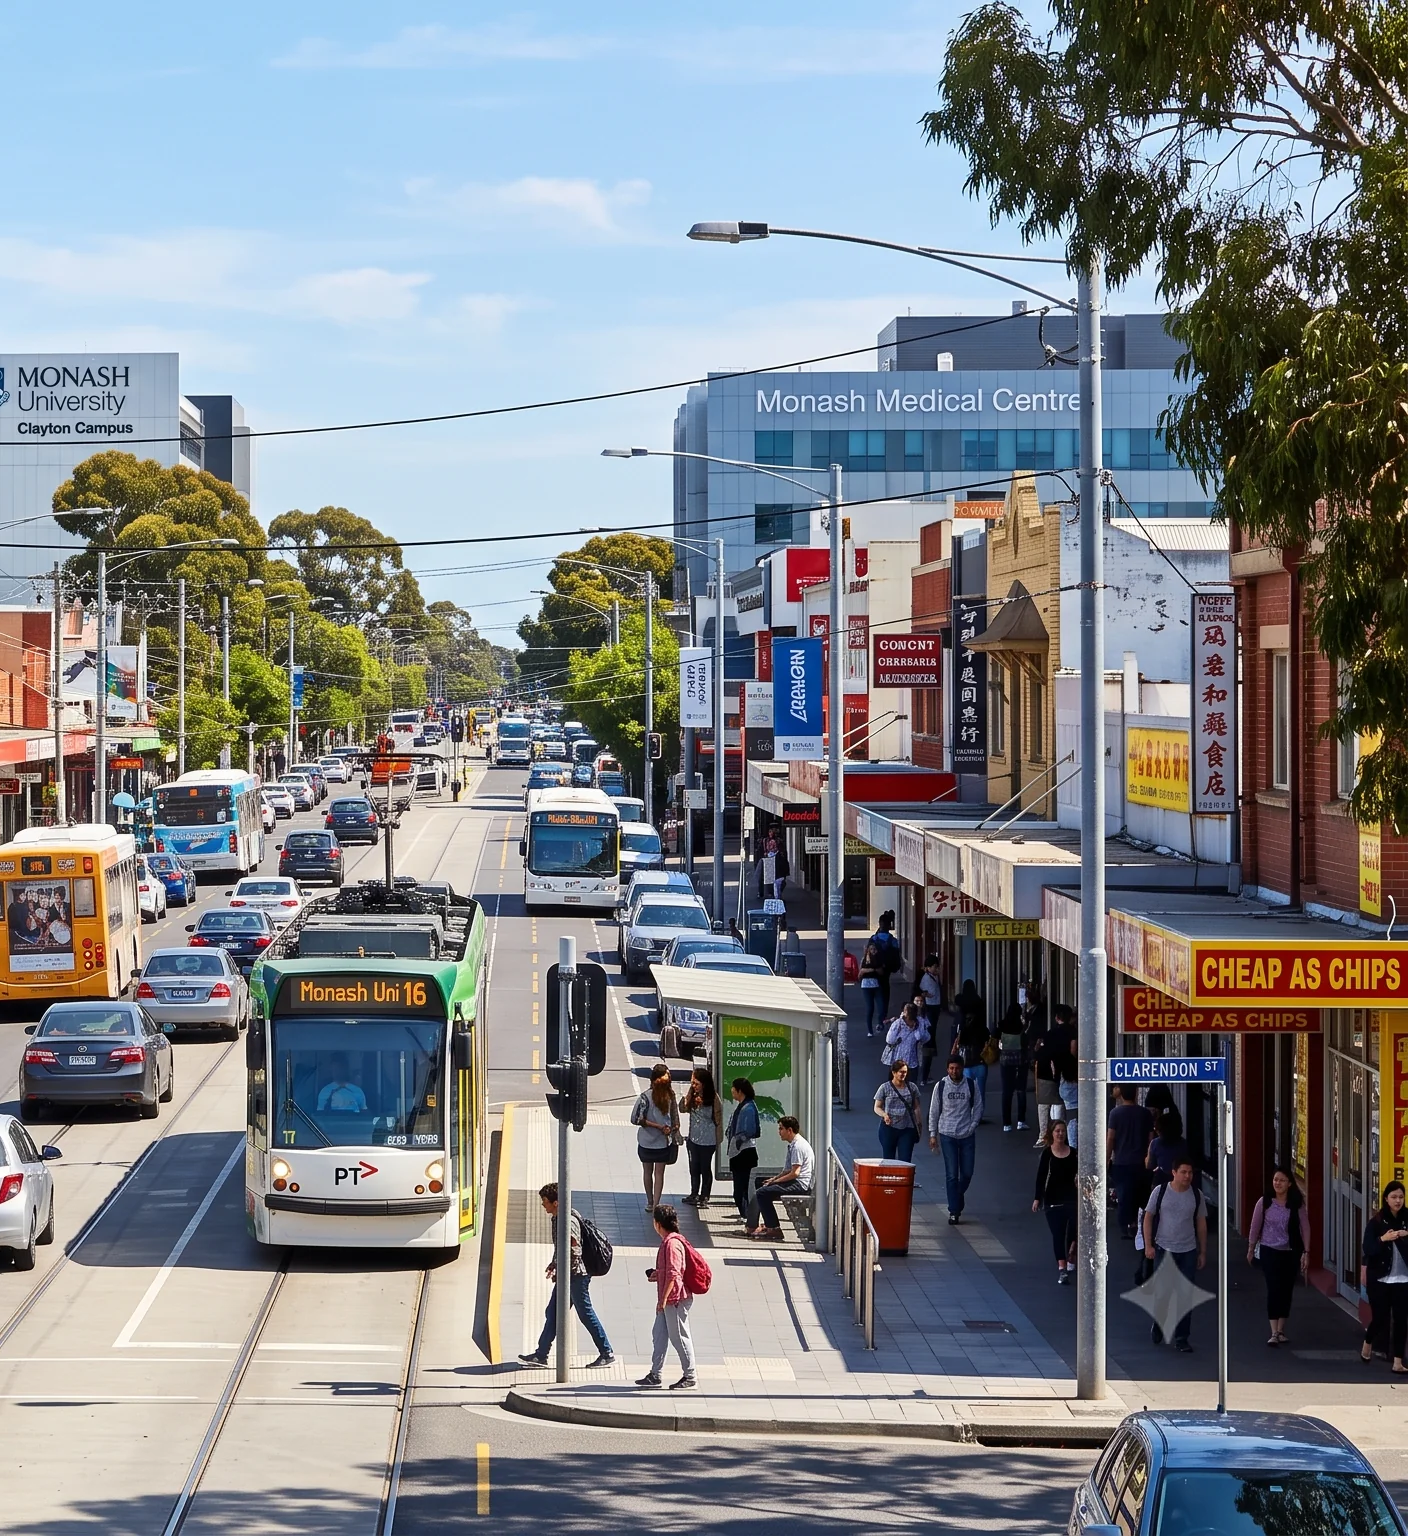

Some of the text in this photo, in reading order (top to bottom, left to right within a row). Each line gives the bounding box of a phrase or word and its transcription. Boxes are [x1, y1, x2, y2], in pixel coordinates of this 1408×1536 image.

[18, 366, 130, 388] MONASH
[18, 390, 126, 416] University
[756, 389, 865, 413] Monash
[876, 388, 983, 413] Medical
[17, 422, 133, 437] Clayton Campus
[1202, 957, 1401, 990] CHEAP AS CHIPS
[299, 981, 427, 1006] Monash Uni 16
[1134, 1013, 1308, 1028] CHEAP AS CHIPS
[1114, 1059, 1219, 1079] CLARENDON ST
[335, 1167, 362, 1186] PT
